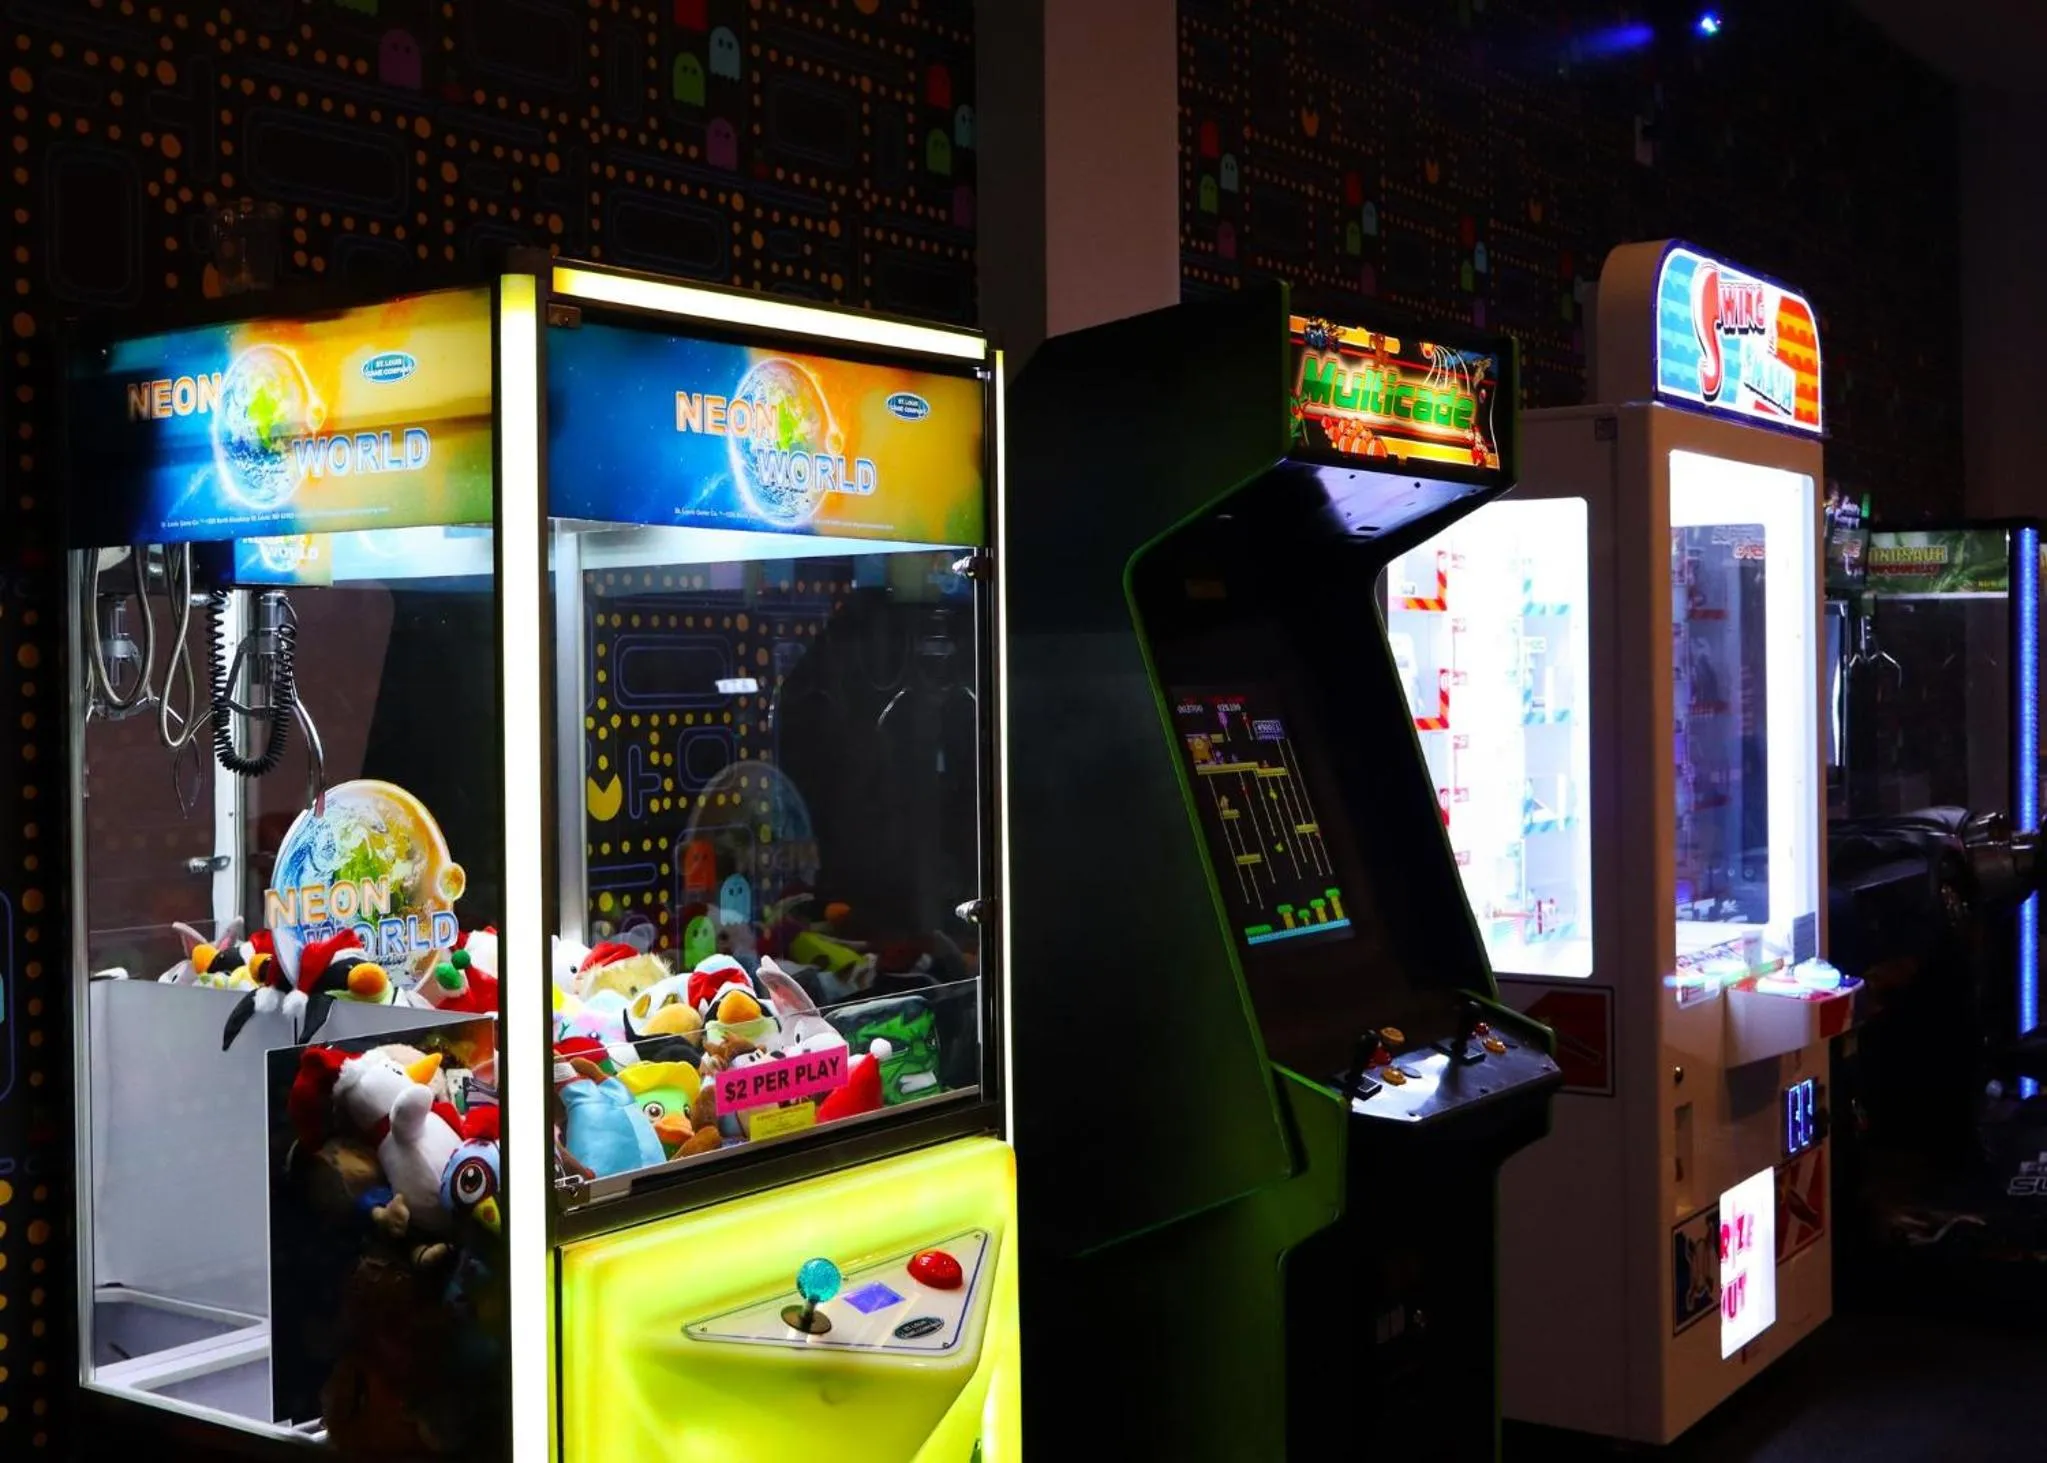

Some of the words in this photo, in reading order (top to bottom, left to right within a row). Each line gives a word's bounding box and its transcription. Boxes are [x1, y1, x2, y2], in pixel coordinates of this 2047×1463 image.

[127, 373, 222, 421] NEON
[1299, 351, 1478, 430] Multicade
[675, 390, 779, 442] NEON
[292, 428, 430, 478] WORLD
[756, 448, 878, 495] WORLD
[264, 875, 391, 929] NEON
[724, 1078, 747, 1103] $2
[753, 1071, 790, 1096] PER
[795, 1056, 840, 1084] PLAY
